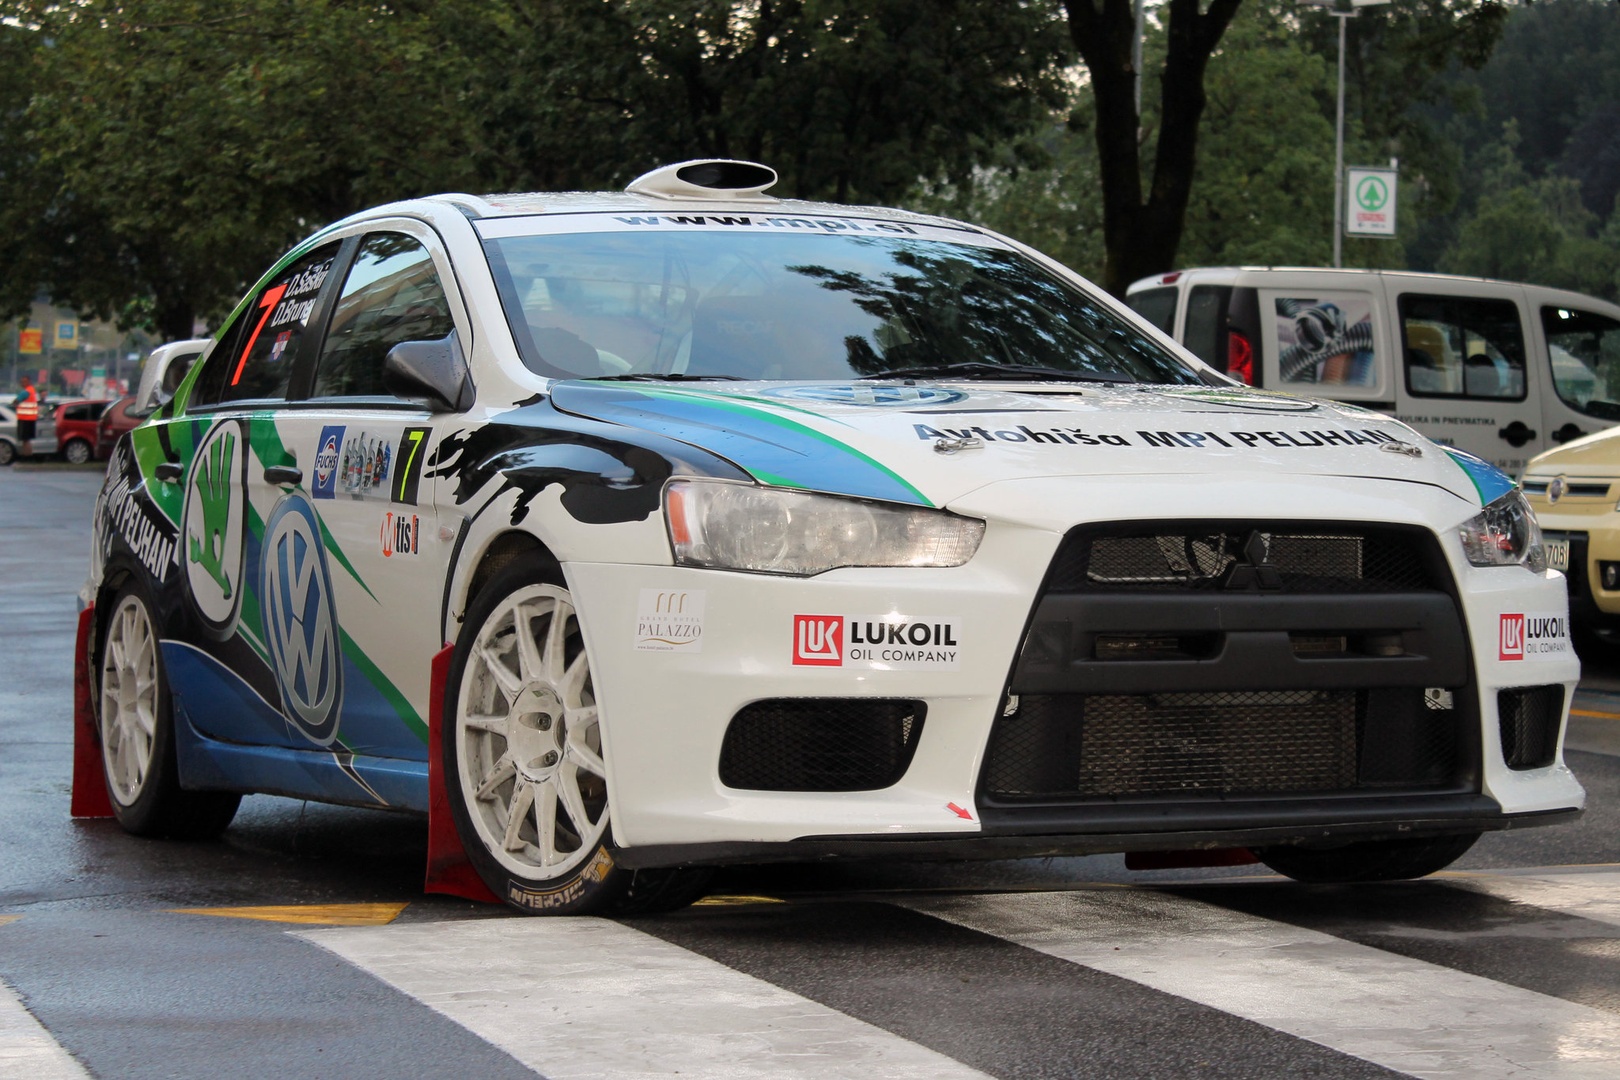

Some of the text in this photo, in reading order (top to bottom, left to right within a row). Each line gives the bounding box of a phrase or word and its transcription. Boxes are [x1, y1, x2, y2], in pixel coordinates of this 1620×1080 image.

[611, 216, 919, 234] www.mpi.si
[231, 283, 288, 386] 7
[1431, 416, 1440, 424] IN
[1442, 417, 1495, 425] PNEVMATIKA
[912, 423, 1397, 447] Avtohiša MPI PELJHAN
[317, 454, 338, 469] FUCHS
[400, 431, 425, 501] 7
[120, 494, 173, 584] PELJHAN
[638, 623, 702, 638] PALAZZO
[850, 621, 958, 646] LUKOIL
[1527, 617, 1566, 639] LUKOIL
[850, 648, 958, 663] OIL COMPANY
[1526, 642, 1567, 654] OIL COMPANY
[509, 879, 586, 909] MICHELIN
